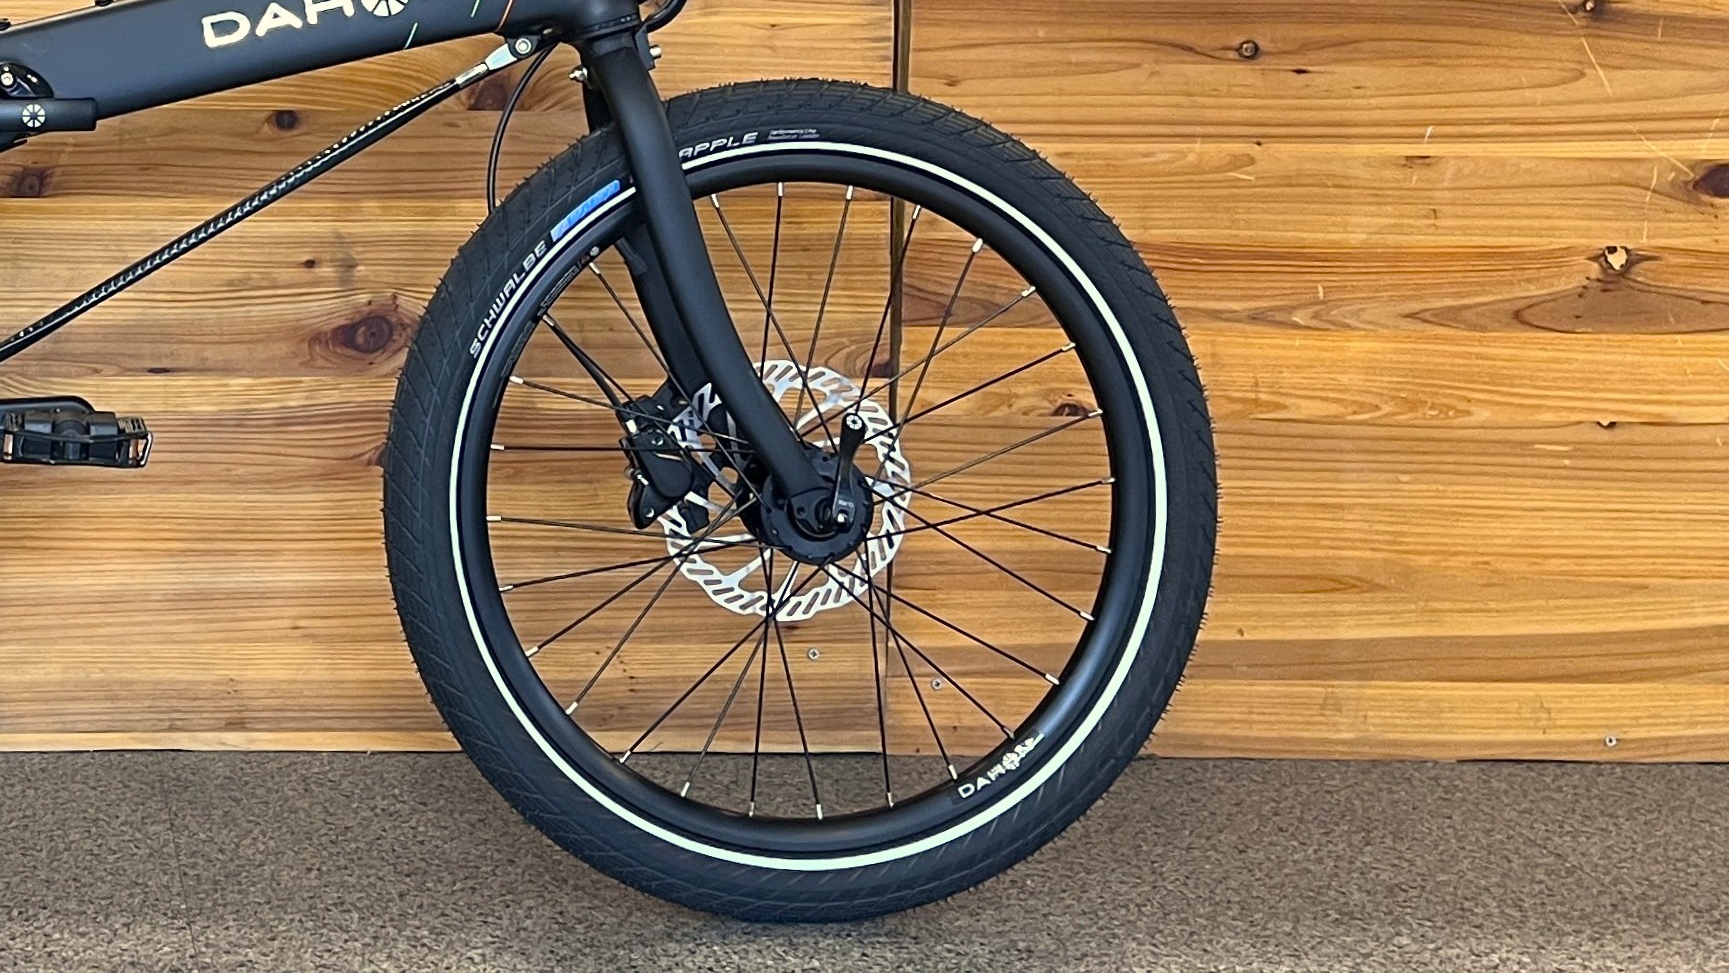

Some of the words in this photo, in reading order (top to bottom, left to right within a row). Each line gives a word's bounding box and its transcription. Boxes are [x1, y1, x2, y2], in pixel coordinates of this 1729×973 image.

[678, 132, 759, 159] APPLE
[468, 239, 548, 359] SCHWALBE
[957, 737, 1036, 799] DAHON
